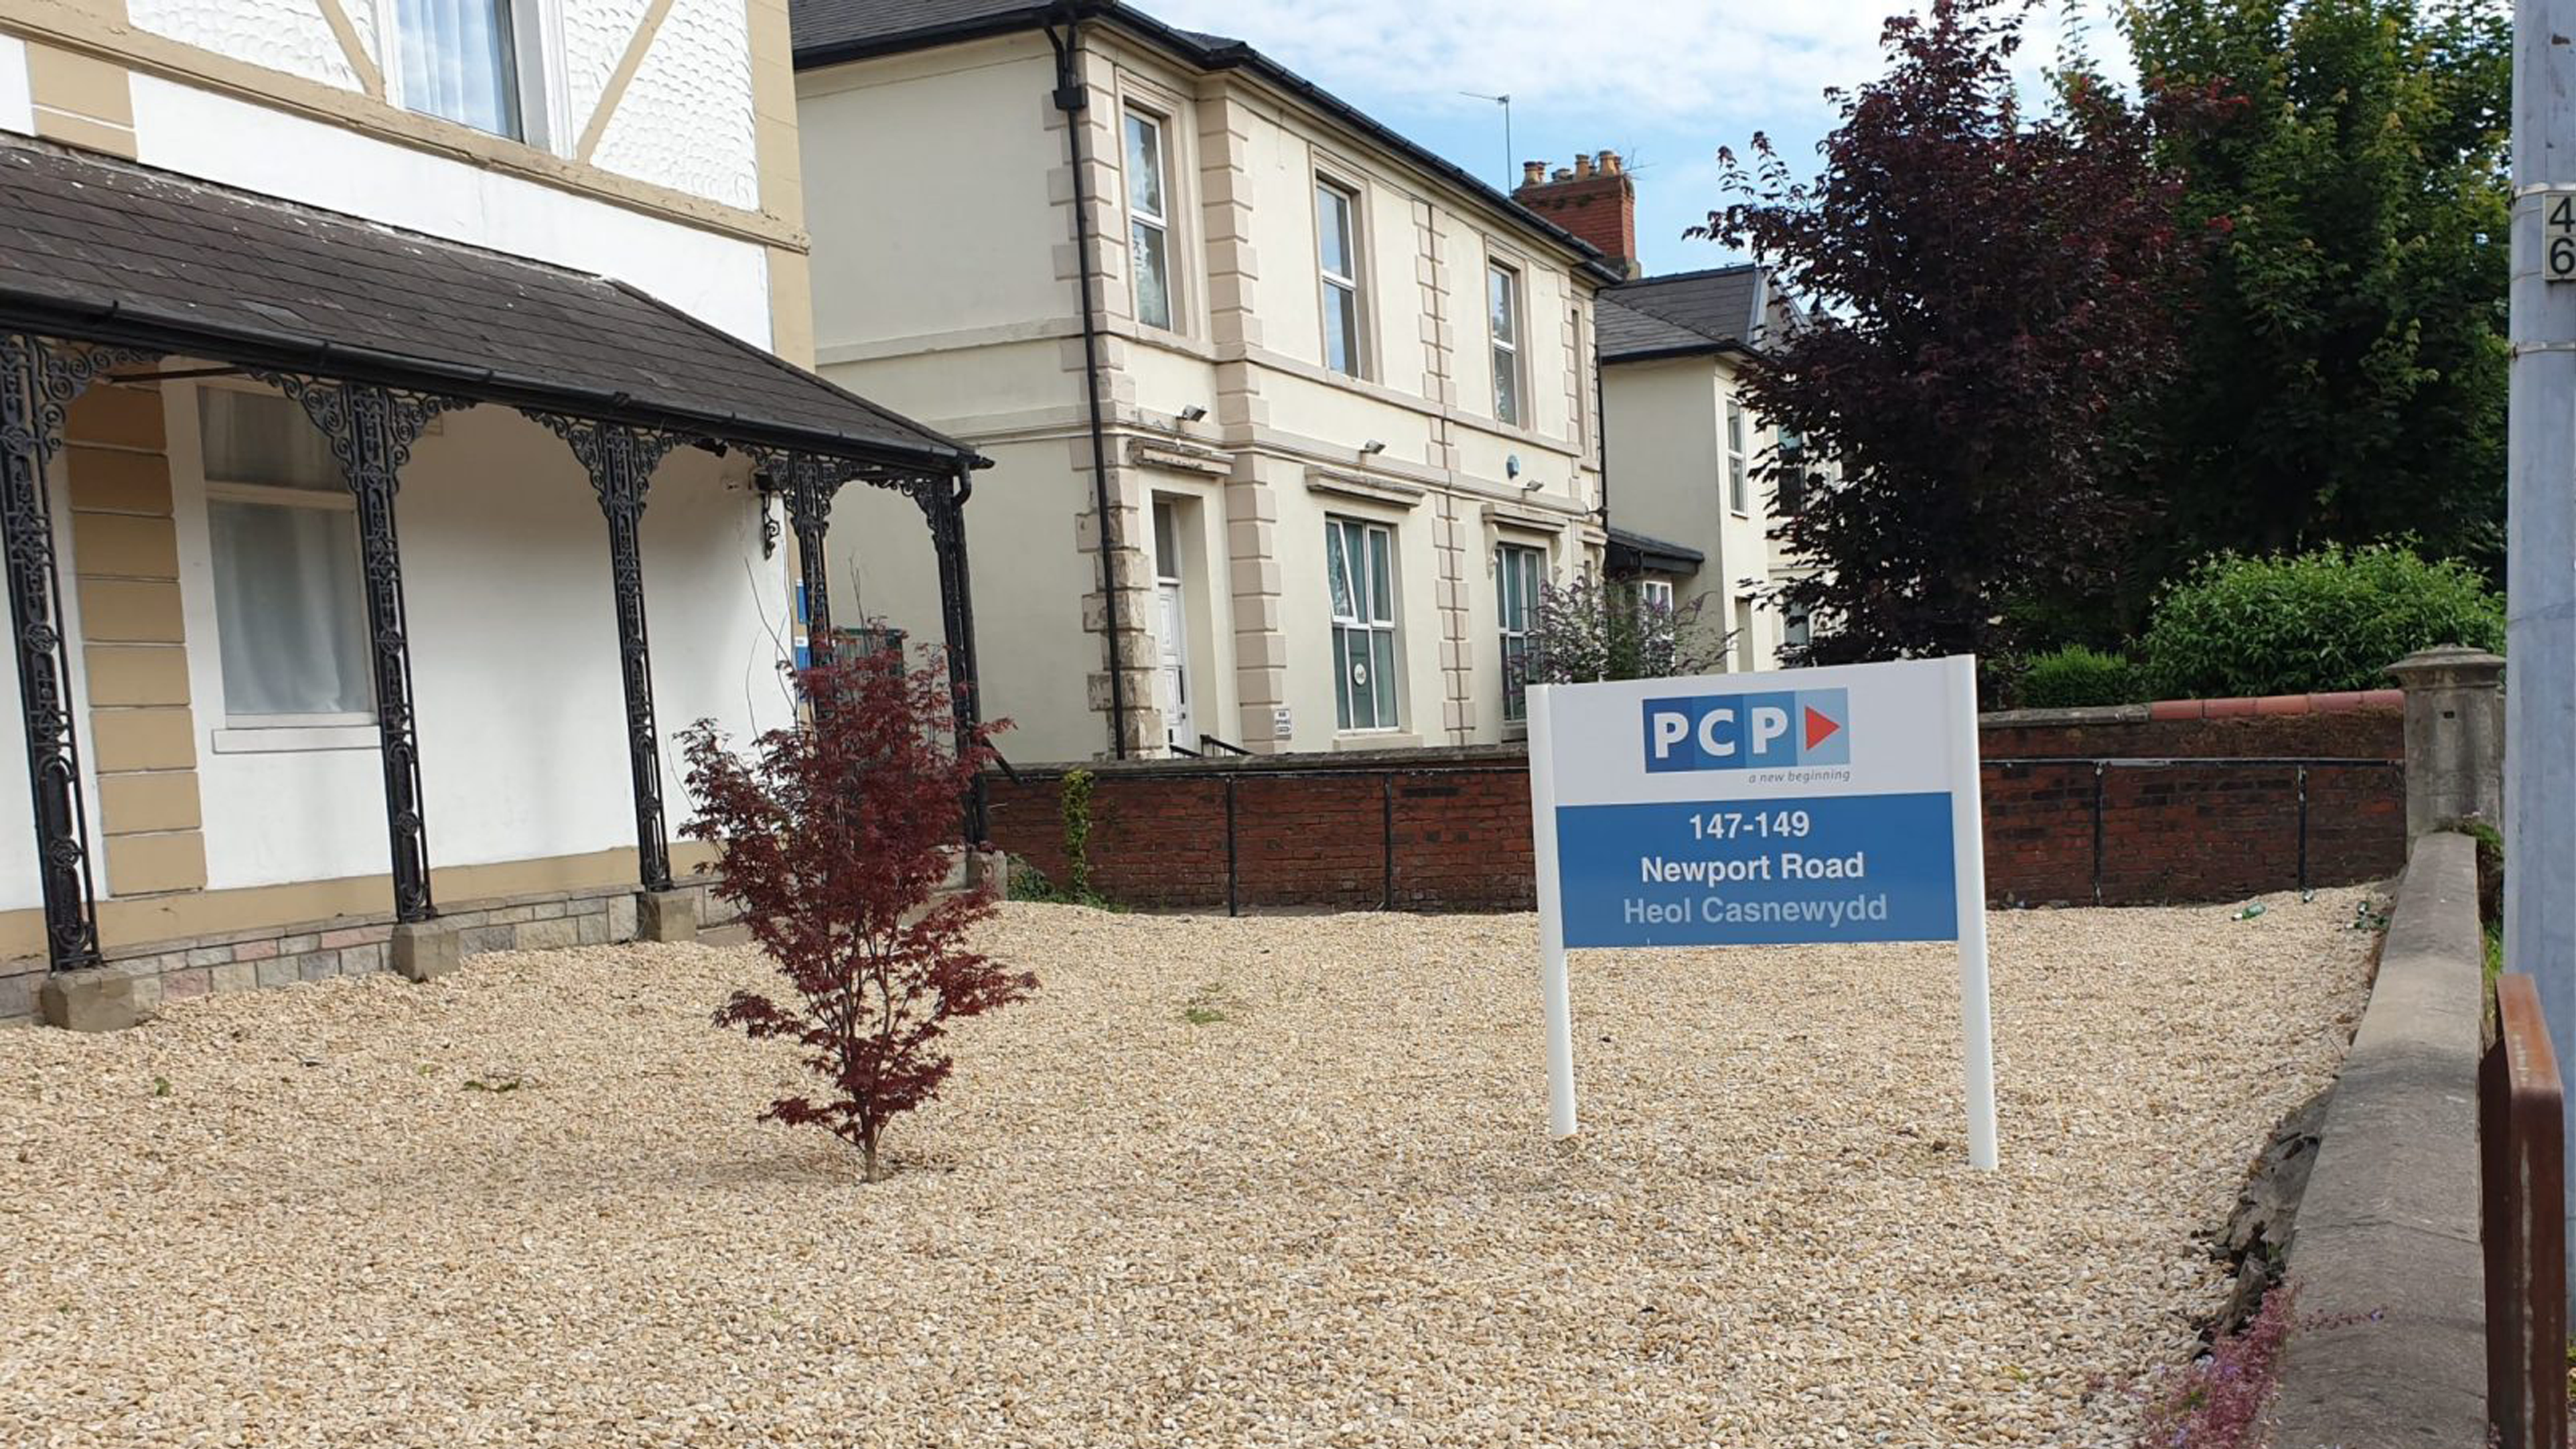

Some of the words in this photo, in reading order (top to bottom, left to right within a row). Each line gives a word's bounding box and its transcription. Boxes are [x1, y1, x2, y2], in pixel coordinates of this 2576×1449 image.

[1653, 706, 1788, 758] PCP
[1760, 773, 1784, 783] new
[1788, 768, 1850, 784] beginning
[1689, 811, 1810, 840] 147-149
[1641, 856, 1771, 887] Newport
[1781, 852, 1865, 879] Road
[1624, 898, 1691, 924] Heol
[1701, 894, 1887, 928] Casnewydd
